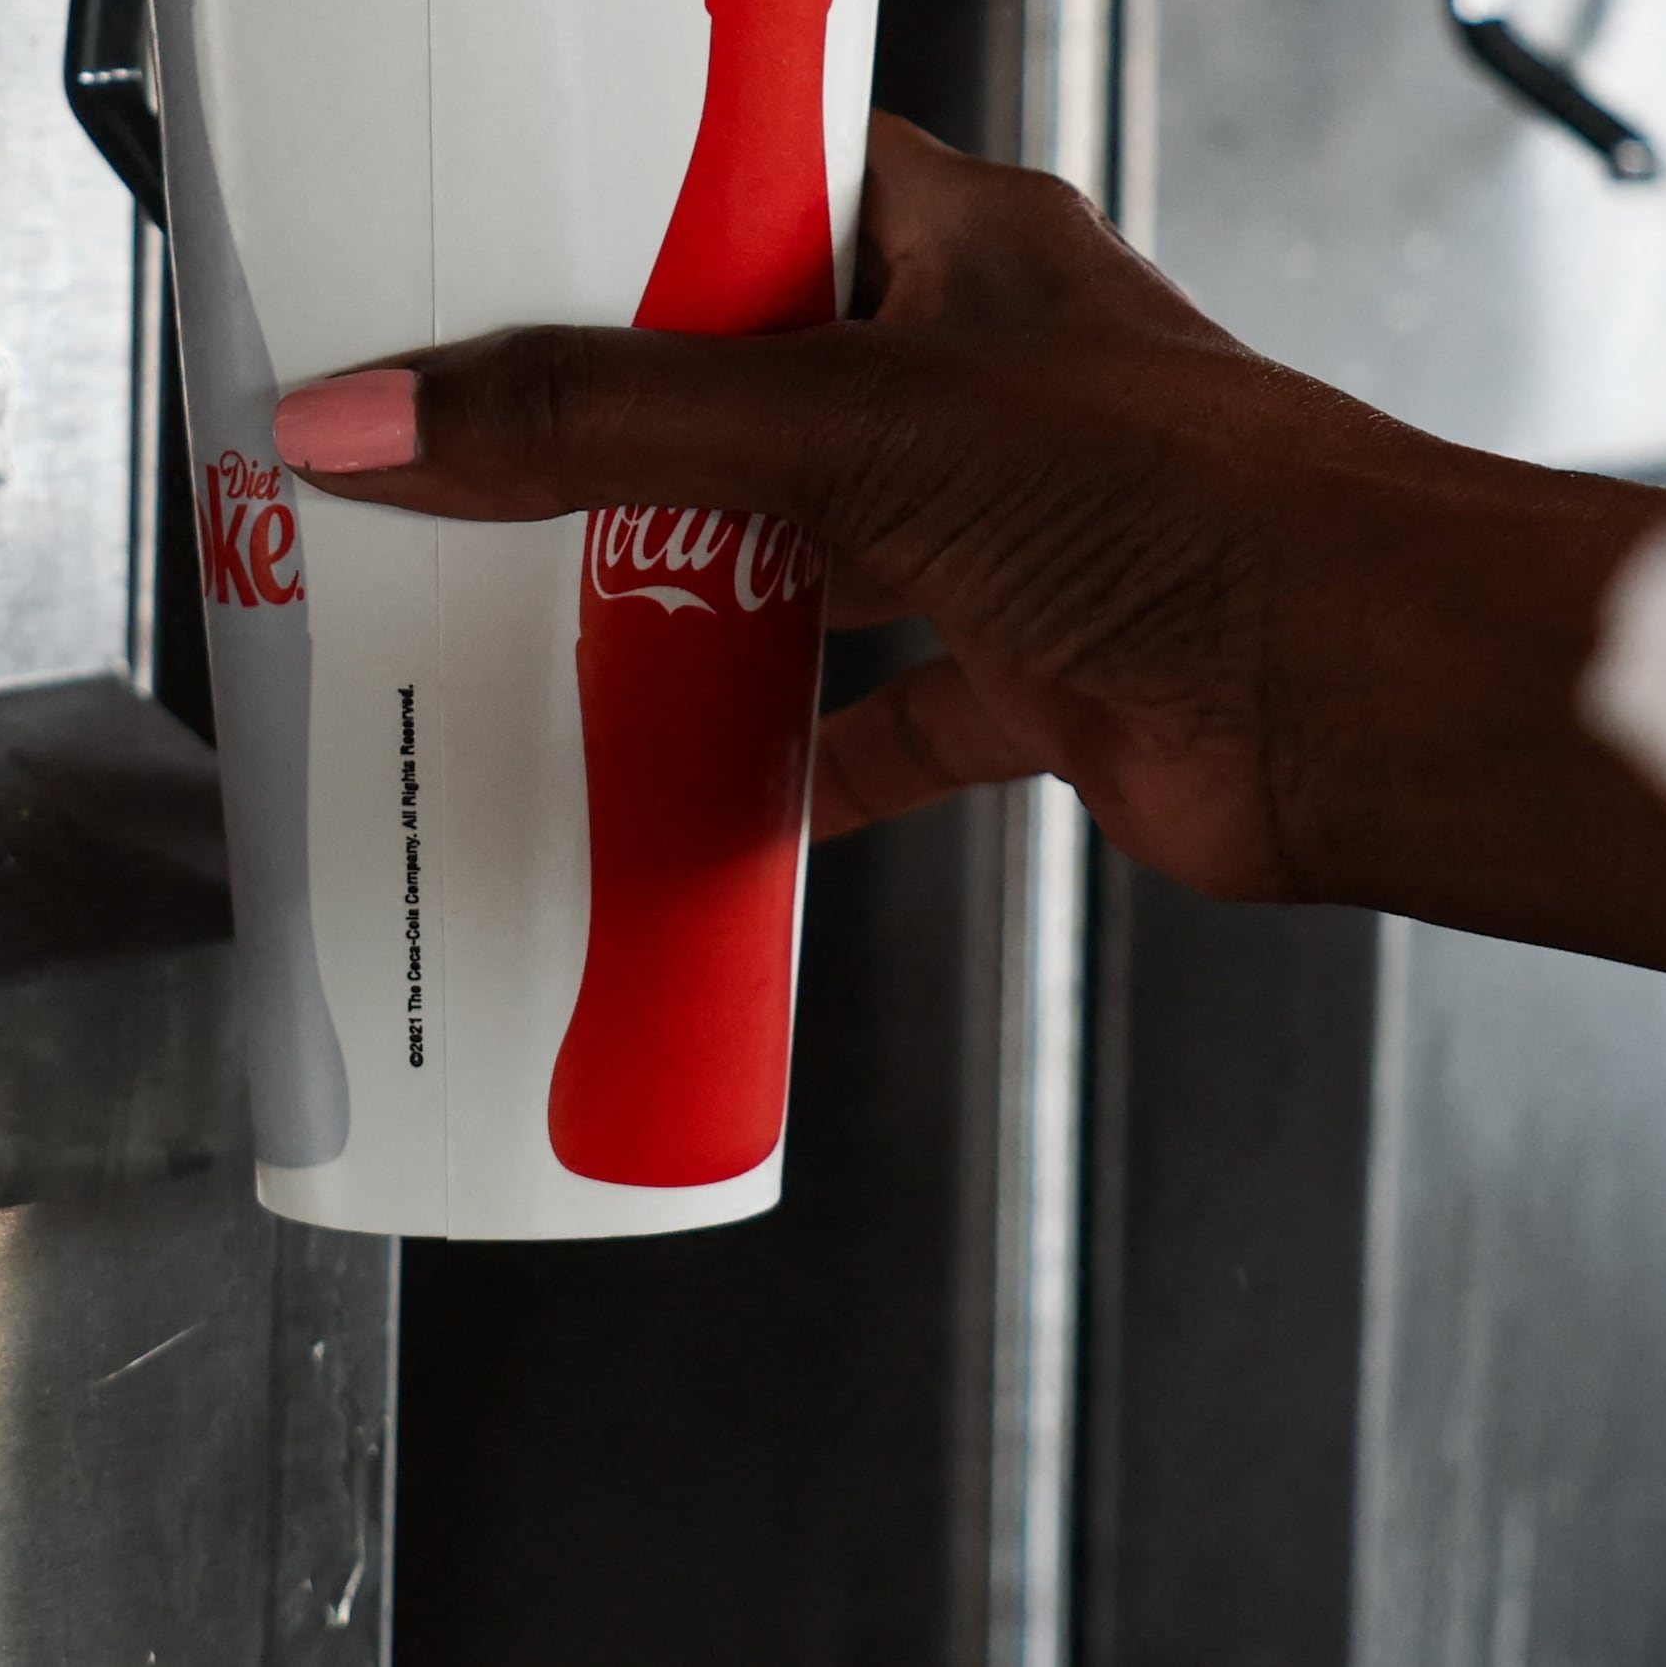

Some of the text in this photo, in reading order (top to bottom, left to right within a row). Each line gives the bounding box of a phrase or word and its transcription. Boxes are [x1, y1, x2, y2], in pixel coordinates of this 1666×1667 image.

[219, 449, 282, 501] Diet
[397, 683, 416, 756] Reserved.
[400, 759, 420, 807] Rights
[401, 810, 418, 831] All
[404, 833, 422, 905] Company.
[405, 908, 422, 982] Coca-Cola
[407, 985, 422, 1013] The
